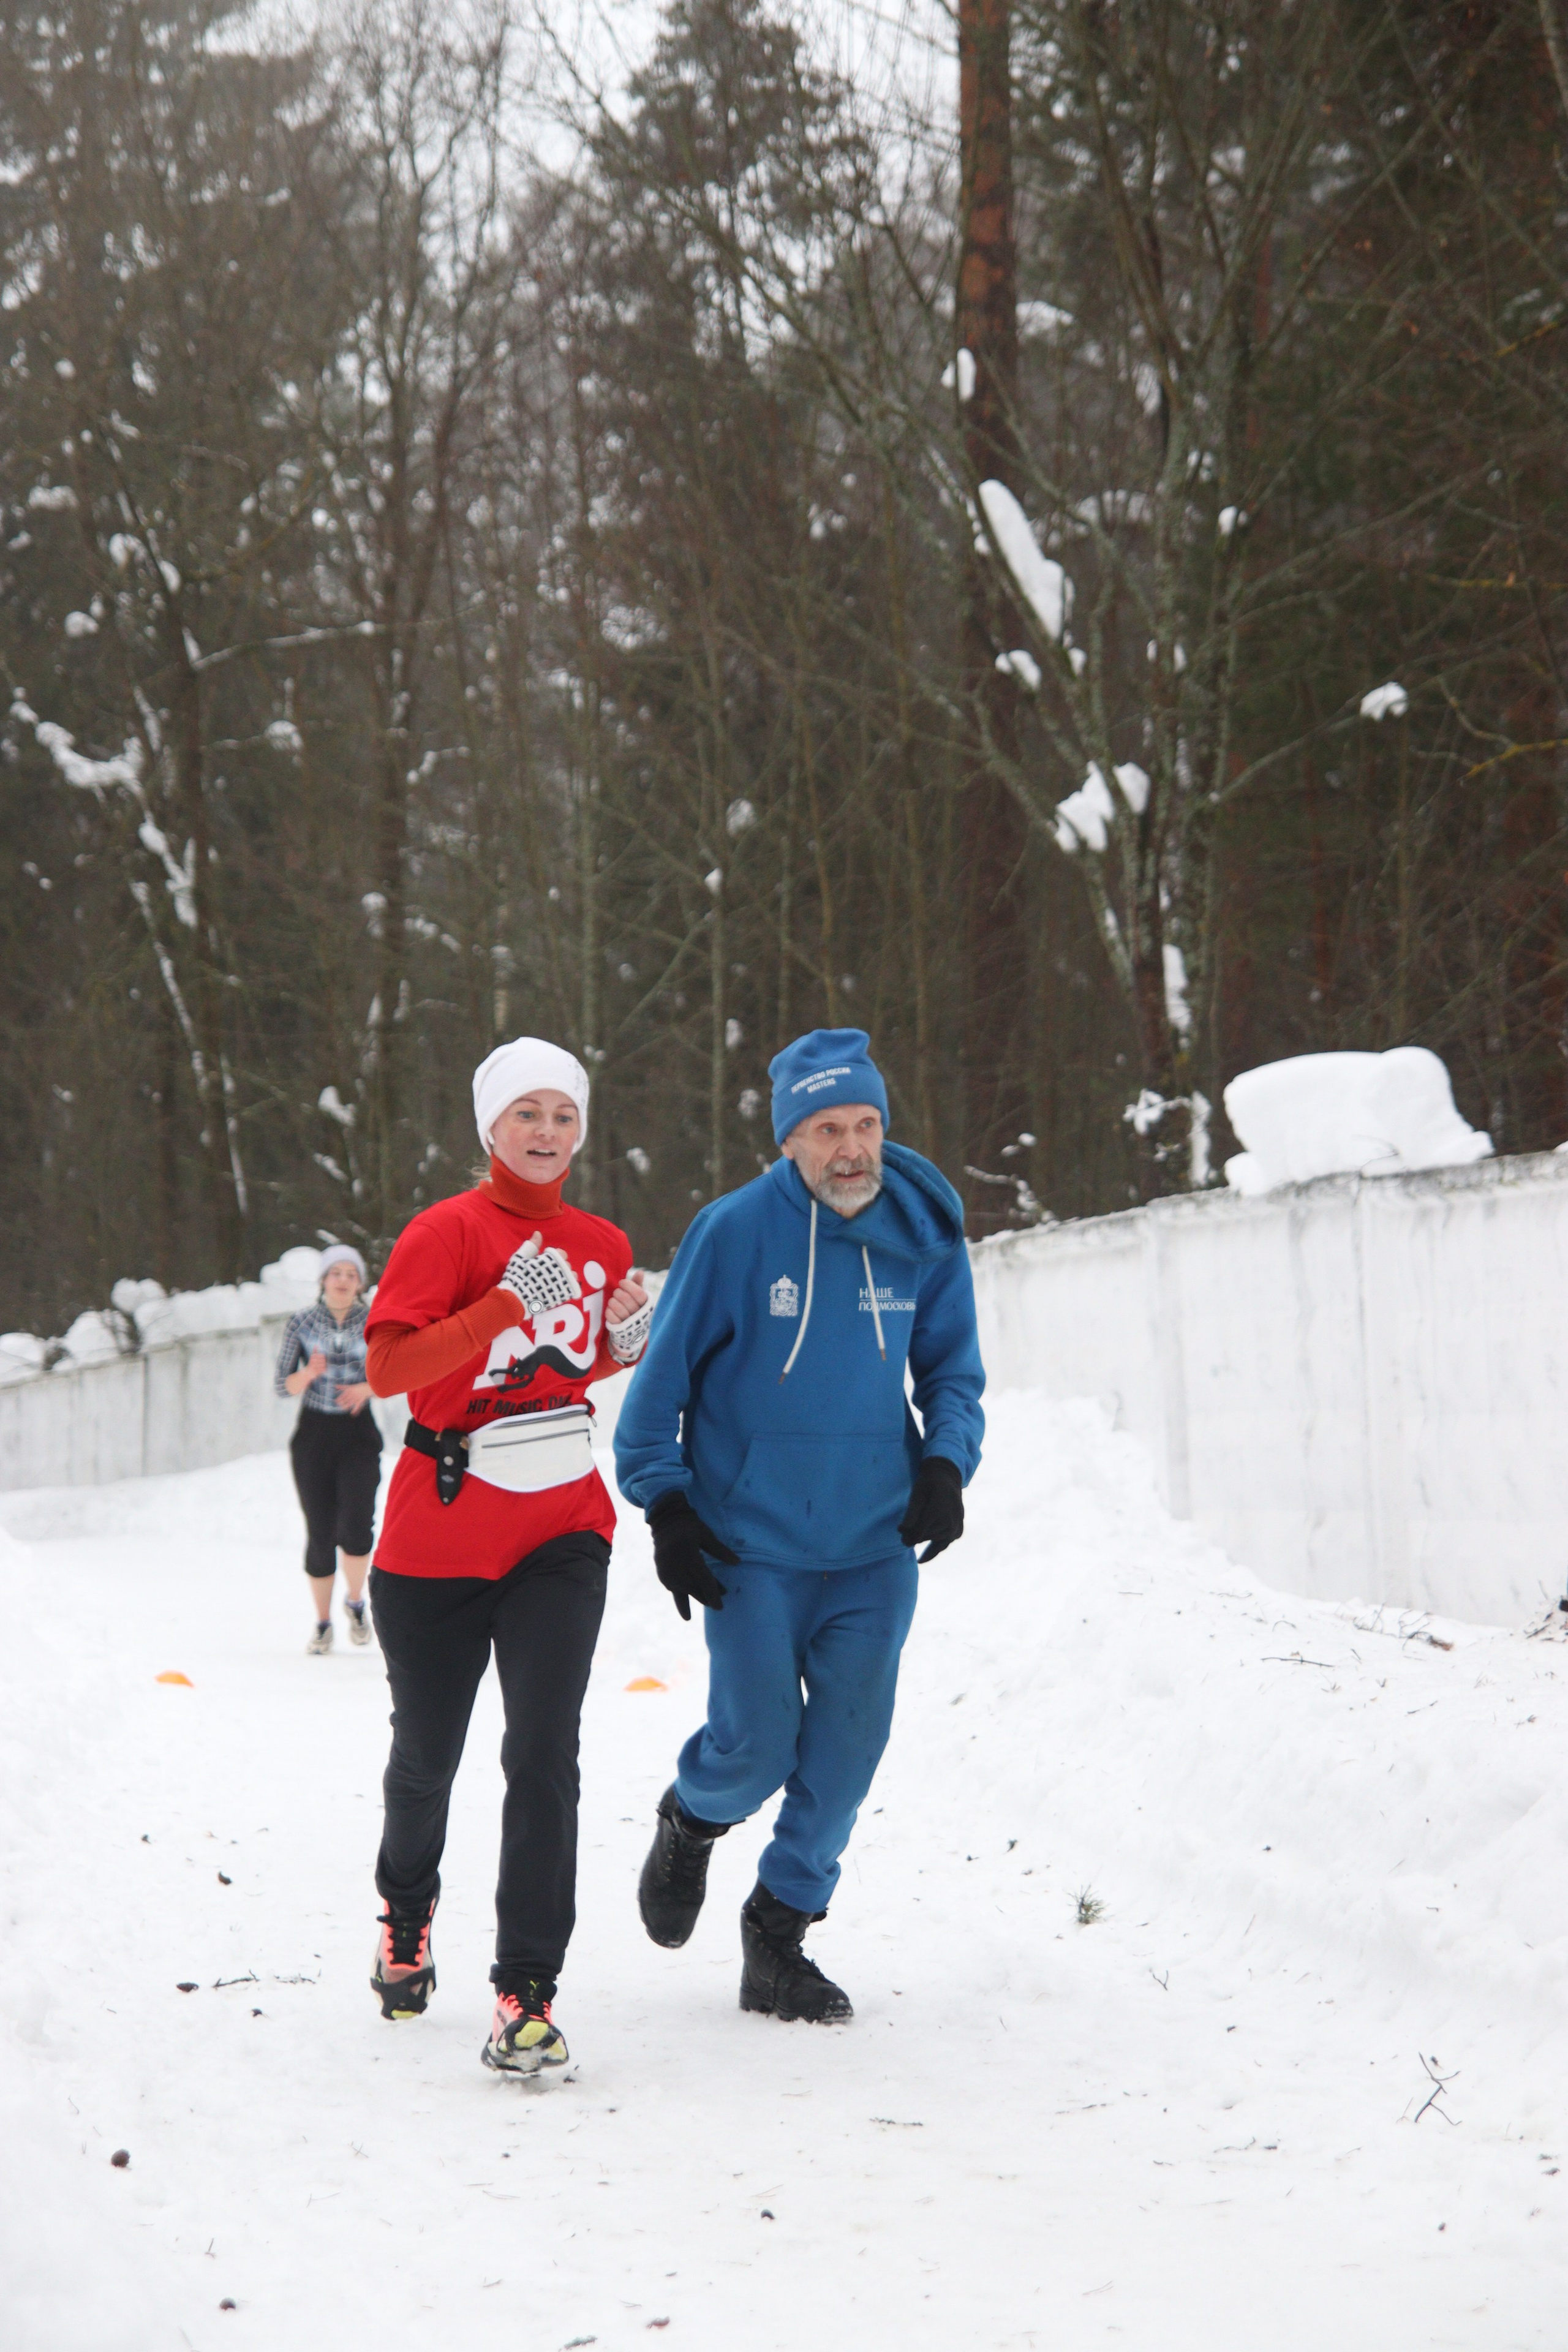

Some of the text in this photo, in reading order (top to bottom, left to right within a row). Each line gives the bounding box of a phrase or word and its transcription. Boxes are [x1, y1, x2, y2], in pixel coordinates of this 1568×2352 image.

[807, 1077, 836, 1093] MASTERS
[859, 1287, 894, 1298] НШЕ
[466, 1398, 491, 1414] HIT
[492, 1398, 543, 1416] MUSIC
